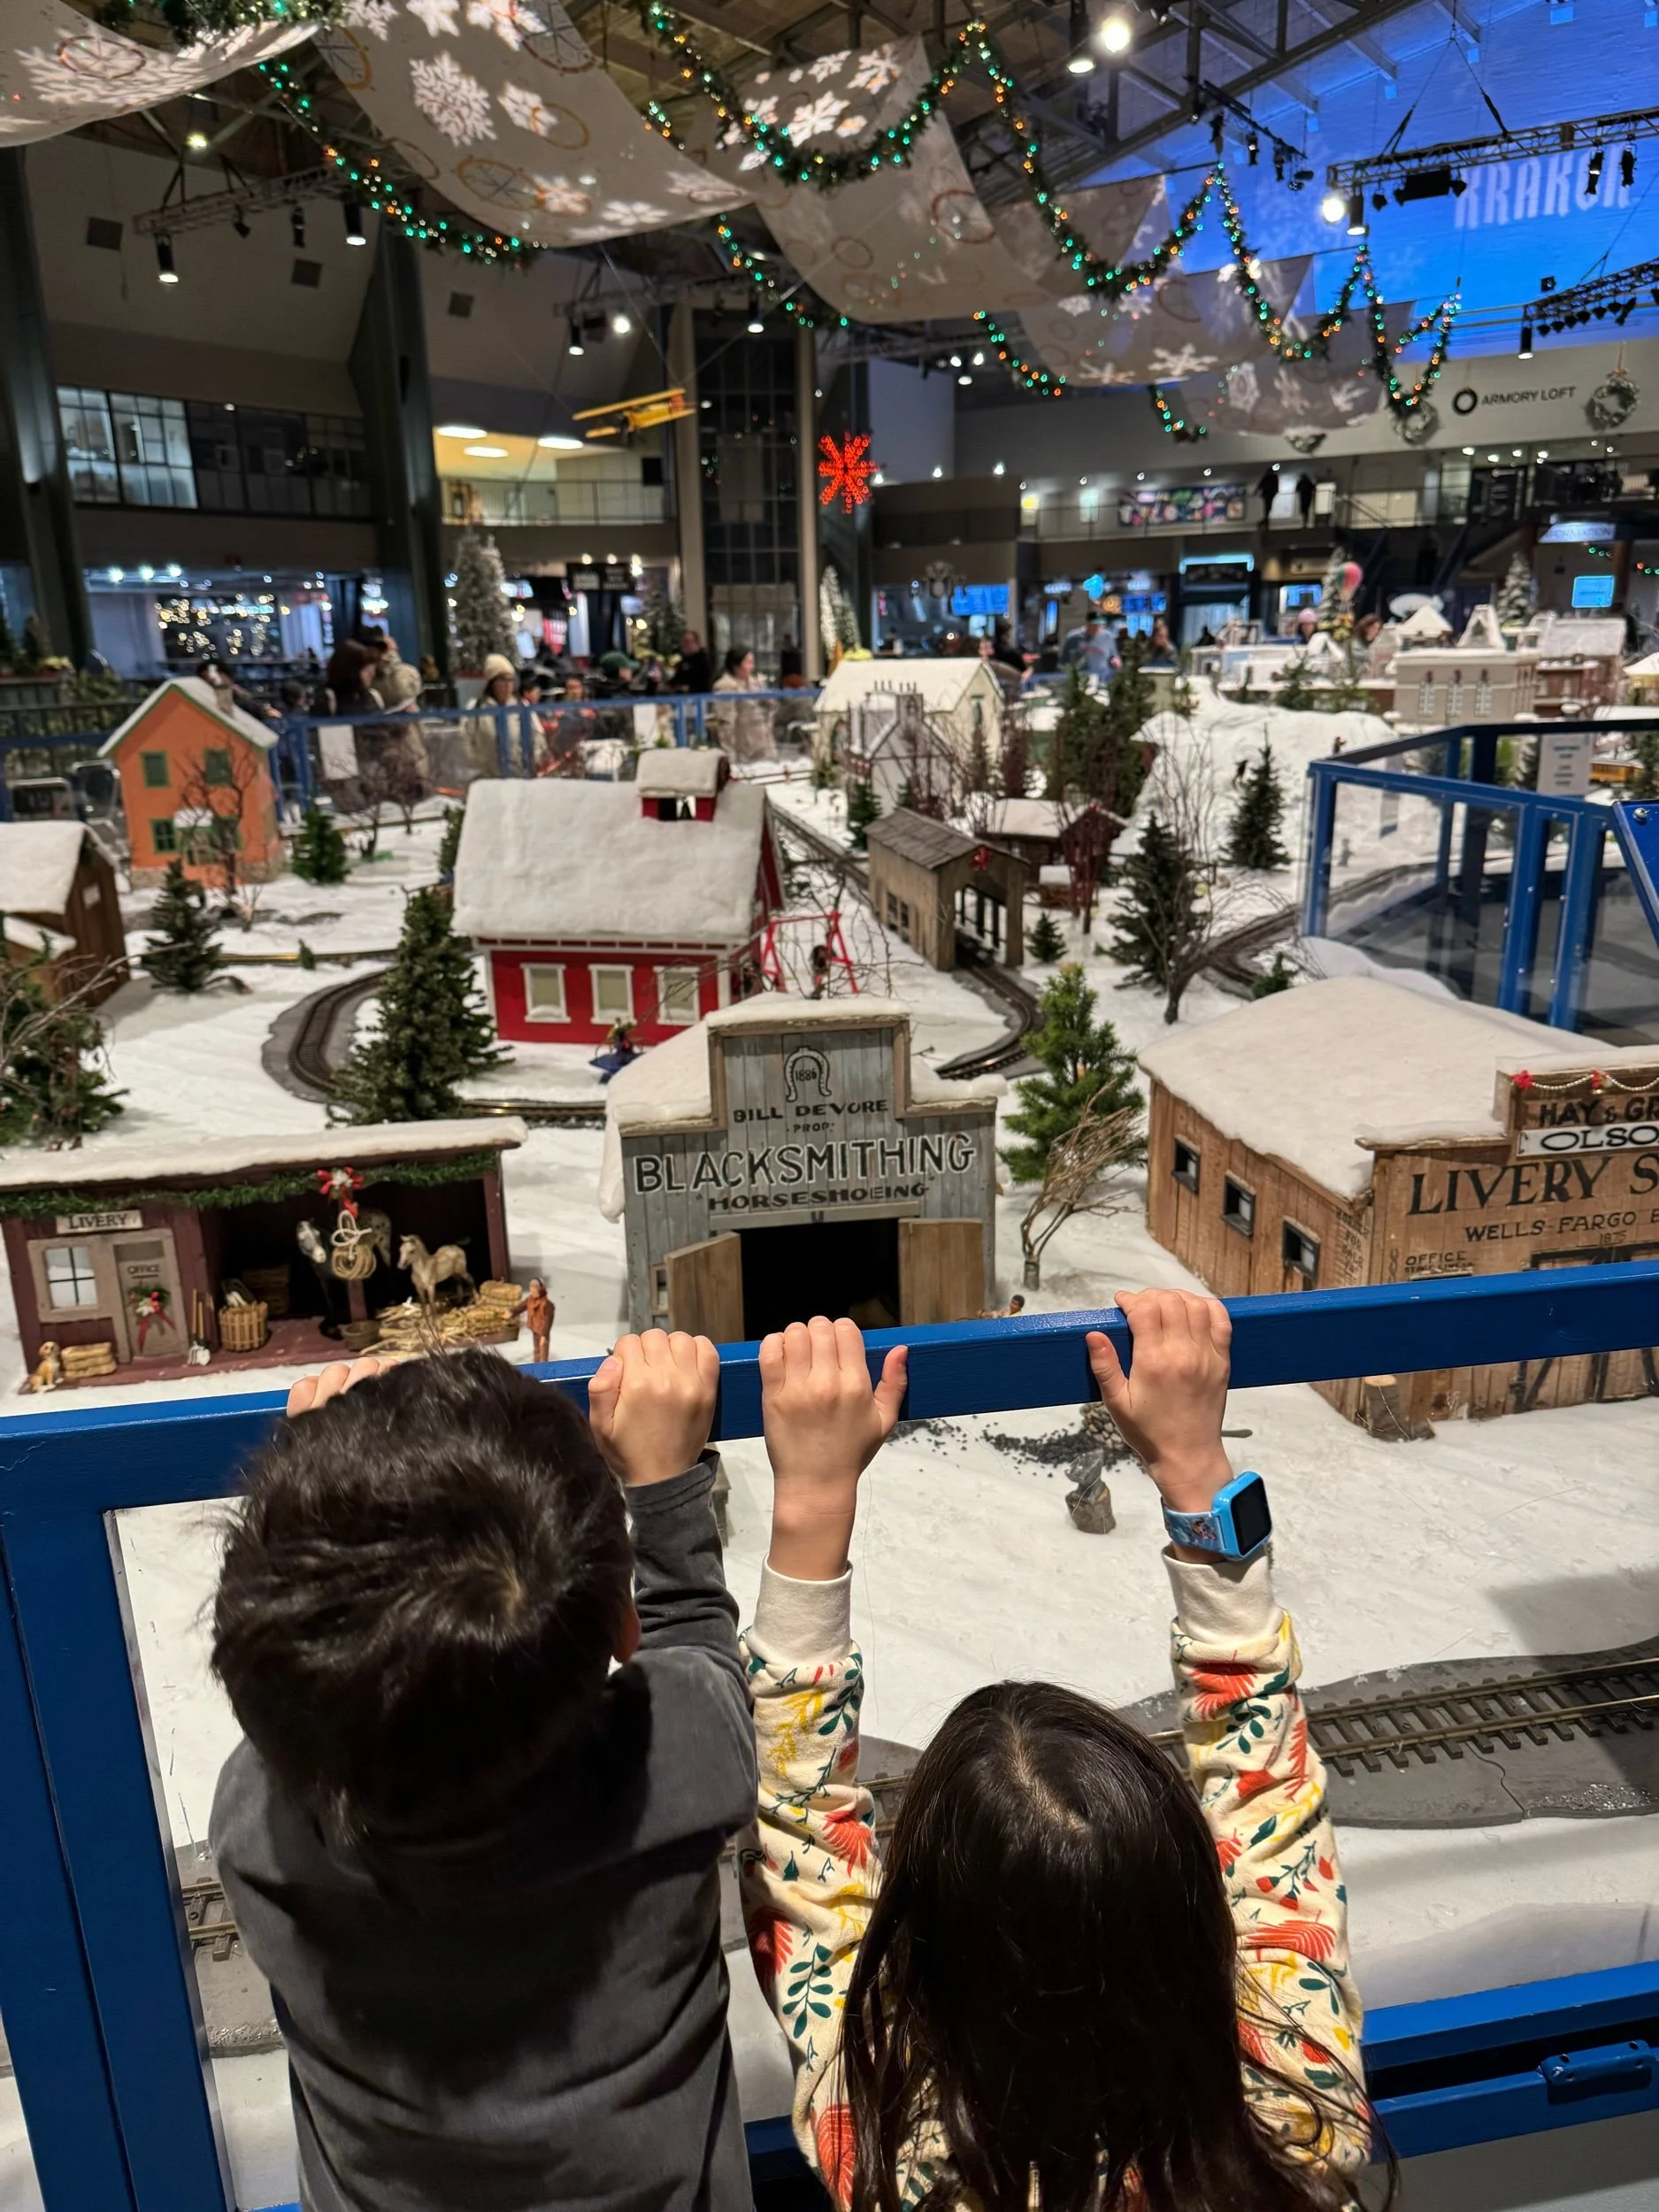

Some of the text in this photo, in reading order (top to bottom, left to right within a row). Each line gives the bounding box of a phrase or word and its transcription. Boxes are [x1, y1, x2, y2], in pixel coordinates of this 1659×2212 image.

[1481, 385, 1577, 406] ARMORY LOFT
[795, 1068, 818, 1081] 1886
[733, 1099, 889, 1123] BILL DEVORE
[1539, 1099, 1601, 1127] HAY
[1540, 1125, 1659, 1151] OLSO
[633, 1132, 978, 1195] BLACKSMITHING
[1406, 1156, 1613, 1216] LIVERY
[69, 1213, 128, 1229] LIVERY
[1405, 1250, 1466, 1265] OFFICE
[127, 1264, 161, 1275] OFFICE
